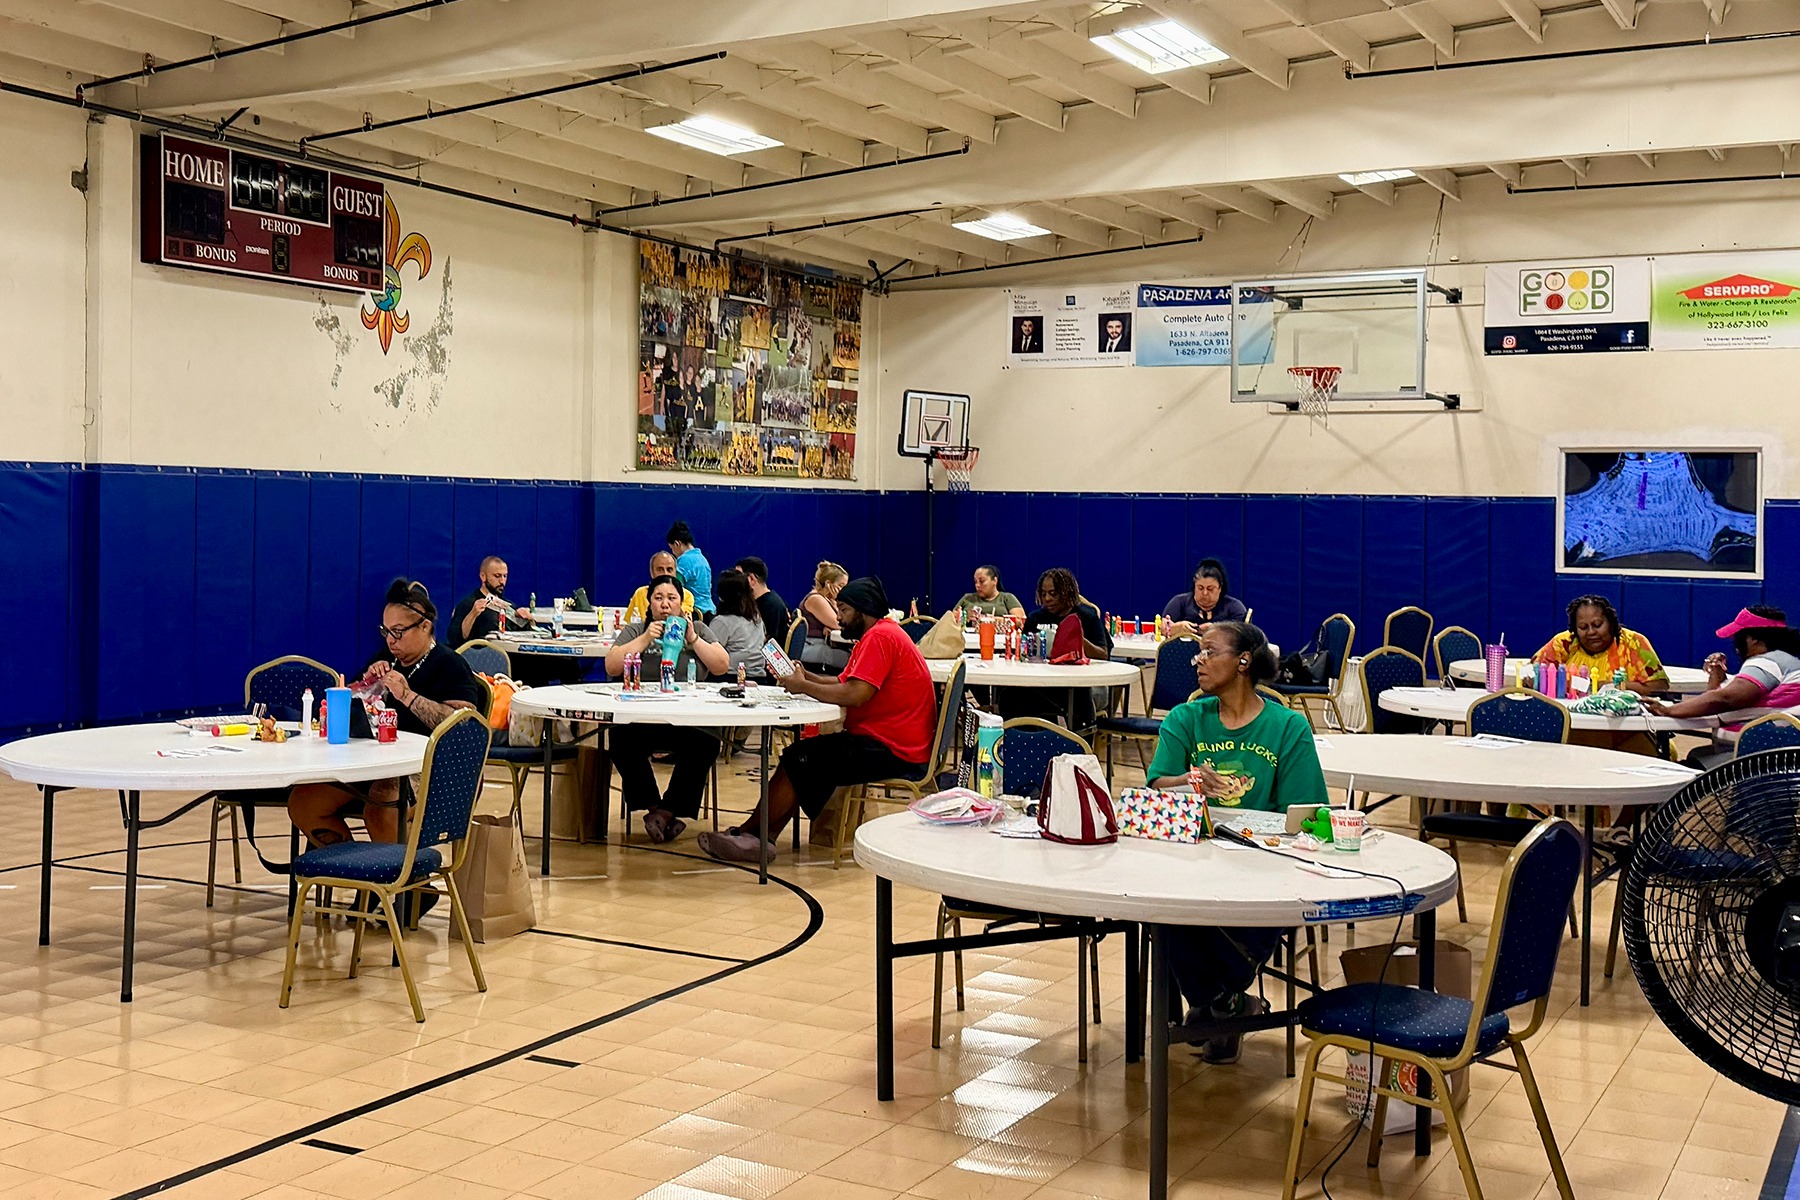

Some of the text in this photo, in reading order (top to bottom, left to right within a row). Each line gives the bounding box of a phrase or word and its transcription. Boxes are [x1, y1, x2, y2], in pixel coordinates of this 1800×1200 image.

[165, 150, 225, 187] HOME
[333, 185, 383, 218] GUEST
[260, 217, 301, 236] PERIOD
[195, 244, 237, 263] BONUS
[323, 265, 359, 281] BONUS
[1143, 289, 1212, 301] PASADENA
[1679, 300, 1691, 308] Fire
[1724, 299, 1752, 308] Cleanup
[1753, 298, 1759, 306] &
[1163, 313, 1247, 324] Complete Auto Cre
[1697, 310, 1734, 319] Hollywood
[1707, 320, 1768, 329] 323-667-3100
[1170, 330, 1188, 338] 1633
[1552, 328, 1584, 336] Washington
[1169, 339, 1202, 347] Pasadena,
